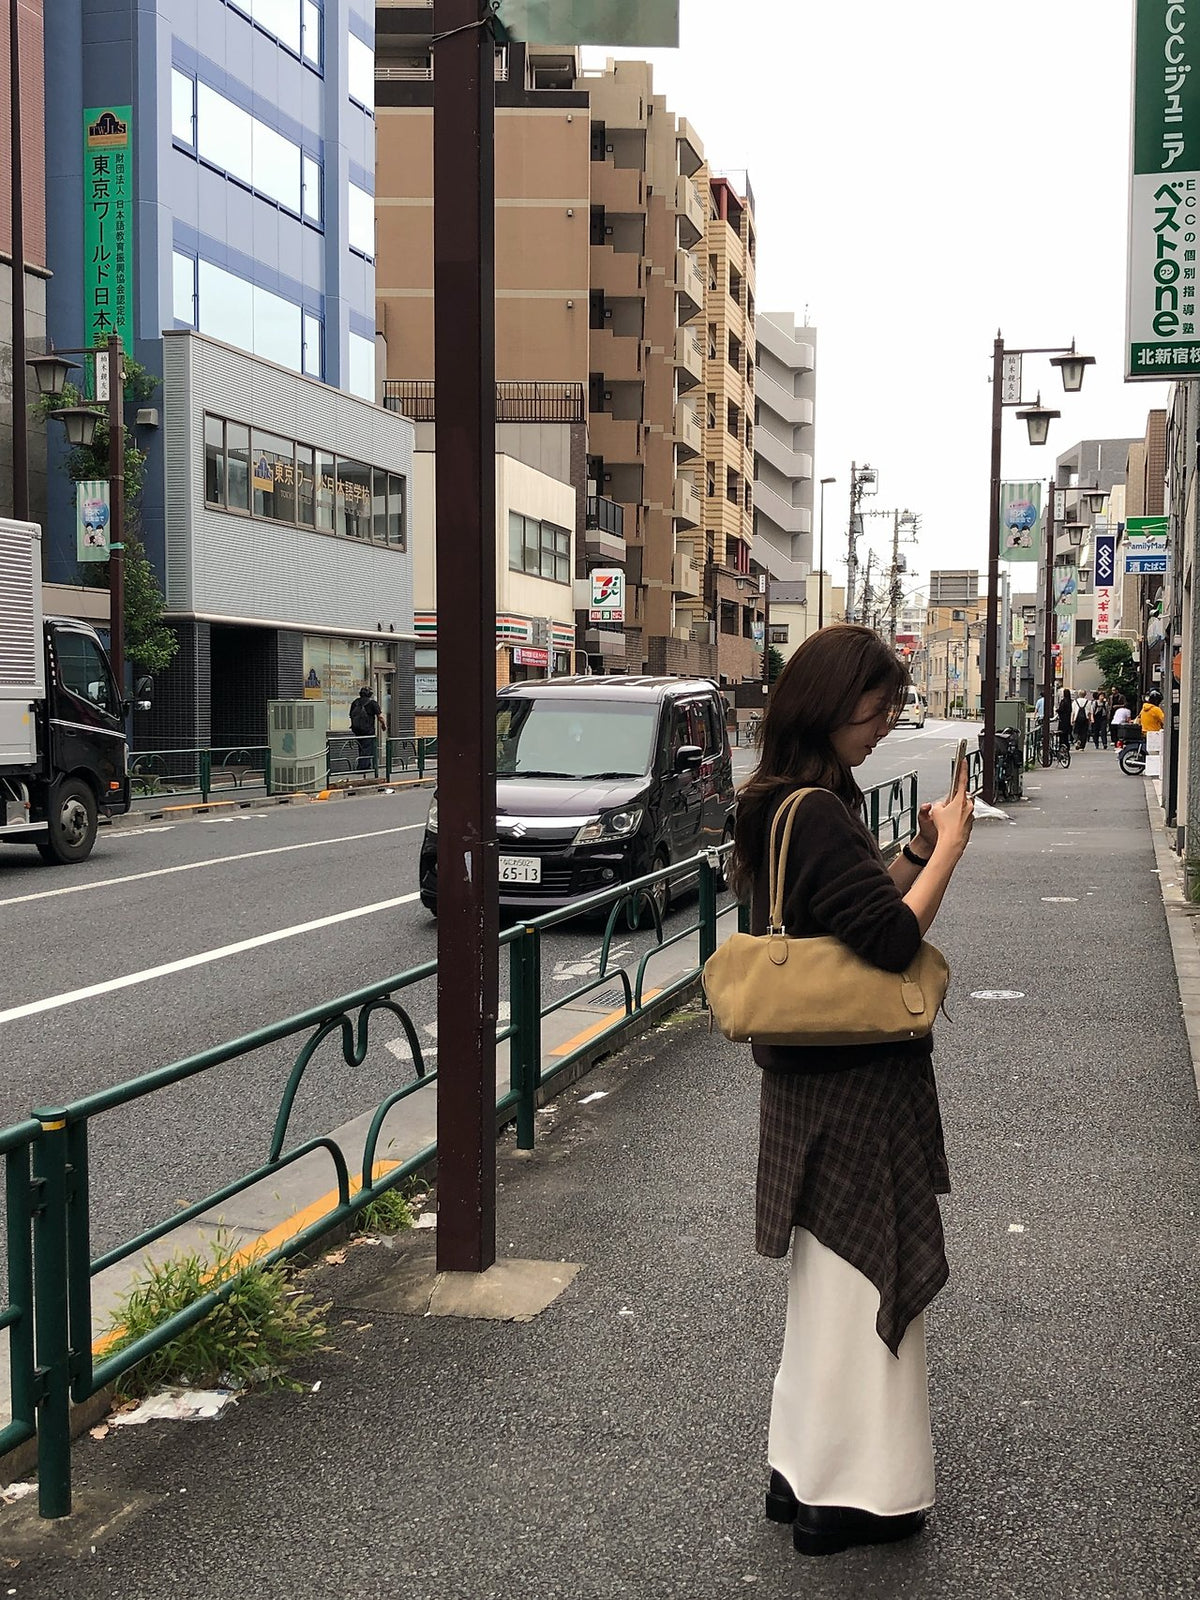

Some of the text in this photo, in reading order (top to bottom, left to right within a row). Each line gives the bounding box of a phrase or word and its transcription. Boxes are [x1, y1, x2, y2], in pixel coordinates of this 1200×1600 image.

[1161, 0, 1191, 169] CCジュニア
[1182, 179, 1196, 335] ECCの個別指導塾
[1144, 562, 1166, 571] たばこ
[503, 867, 538, 881] 65-13
